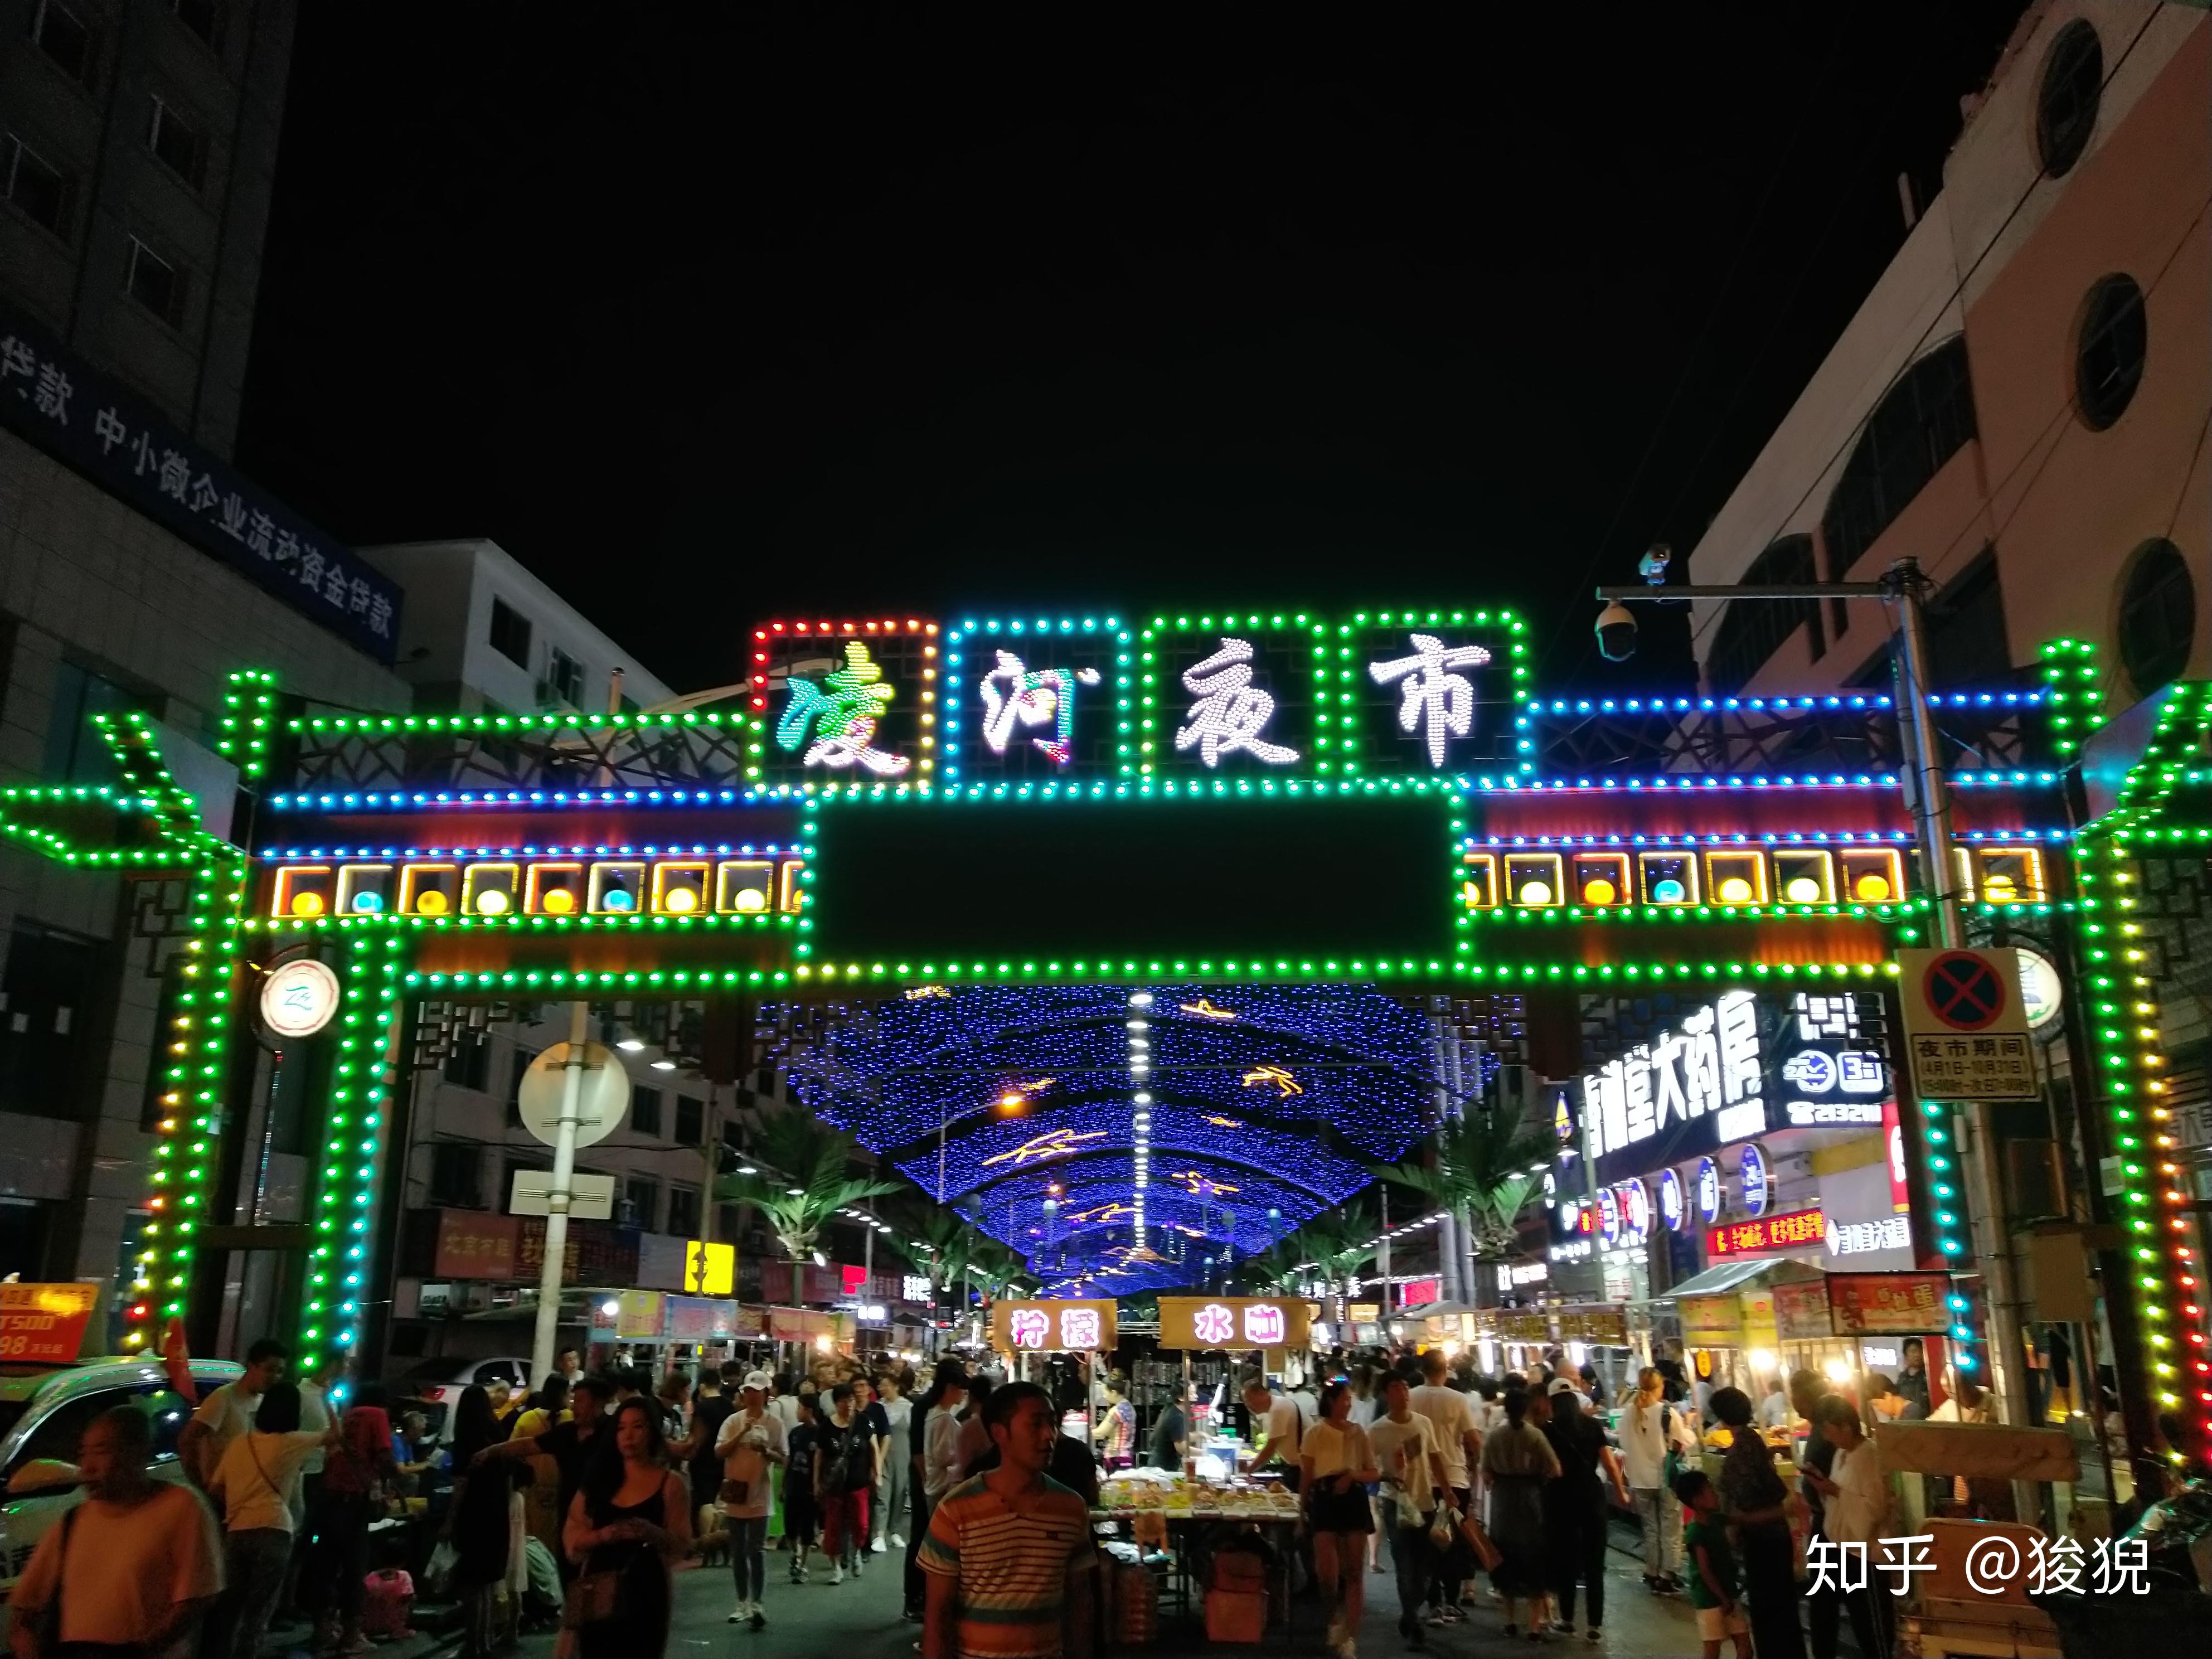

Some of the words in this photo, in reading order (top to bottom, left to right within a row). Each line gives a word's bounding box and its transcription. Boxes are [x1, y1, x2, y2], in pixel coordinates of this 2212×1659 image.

[95, 406, 394, 639] 中小微企业流动资金贷款
[1918, 1039, 2024, 1058] 夜市期间
[1011, 1308, 1100, 1348] 柠檬
